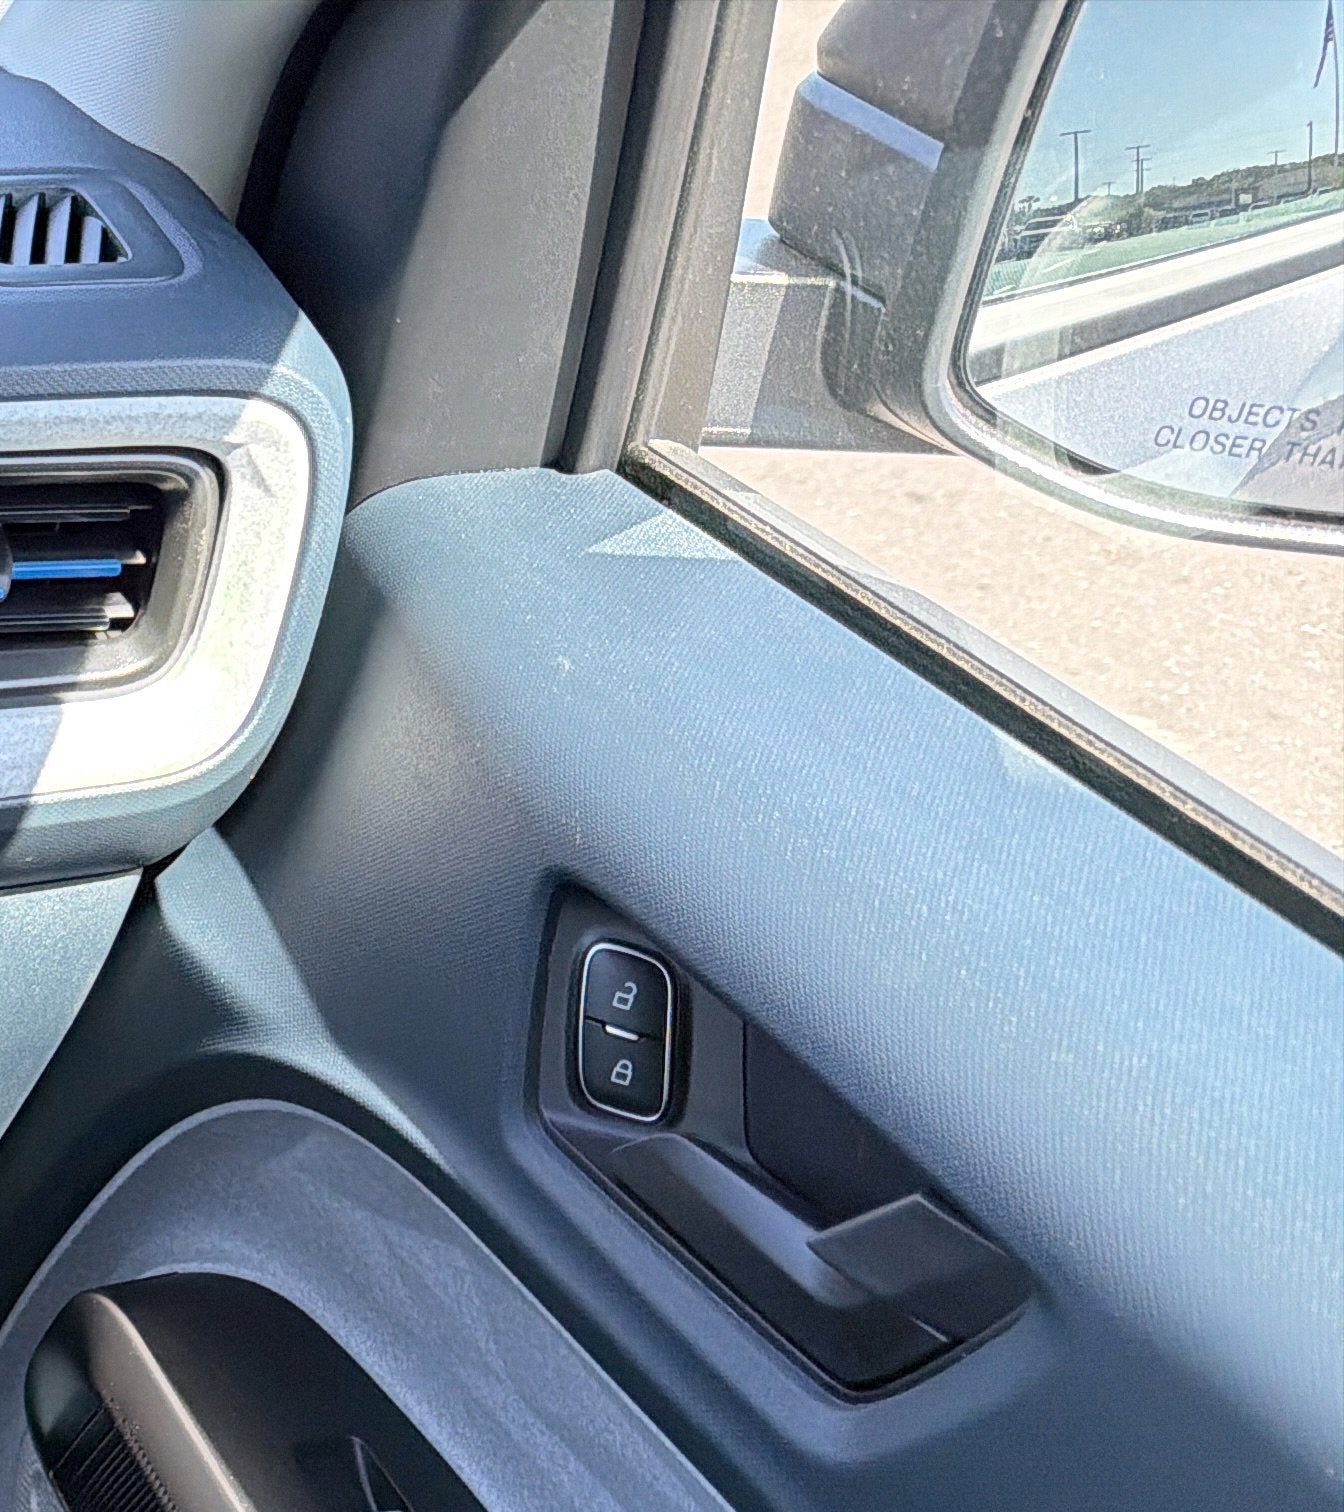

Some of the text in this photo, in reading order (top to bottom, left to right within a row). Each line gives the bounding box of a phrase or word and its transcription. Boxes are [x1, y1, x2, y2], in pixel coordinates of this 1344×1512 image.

[1188, 396, 1321, 432] OBJECTS
[1154, 425, 1344, 469] CLOSER THA
